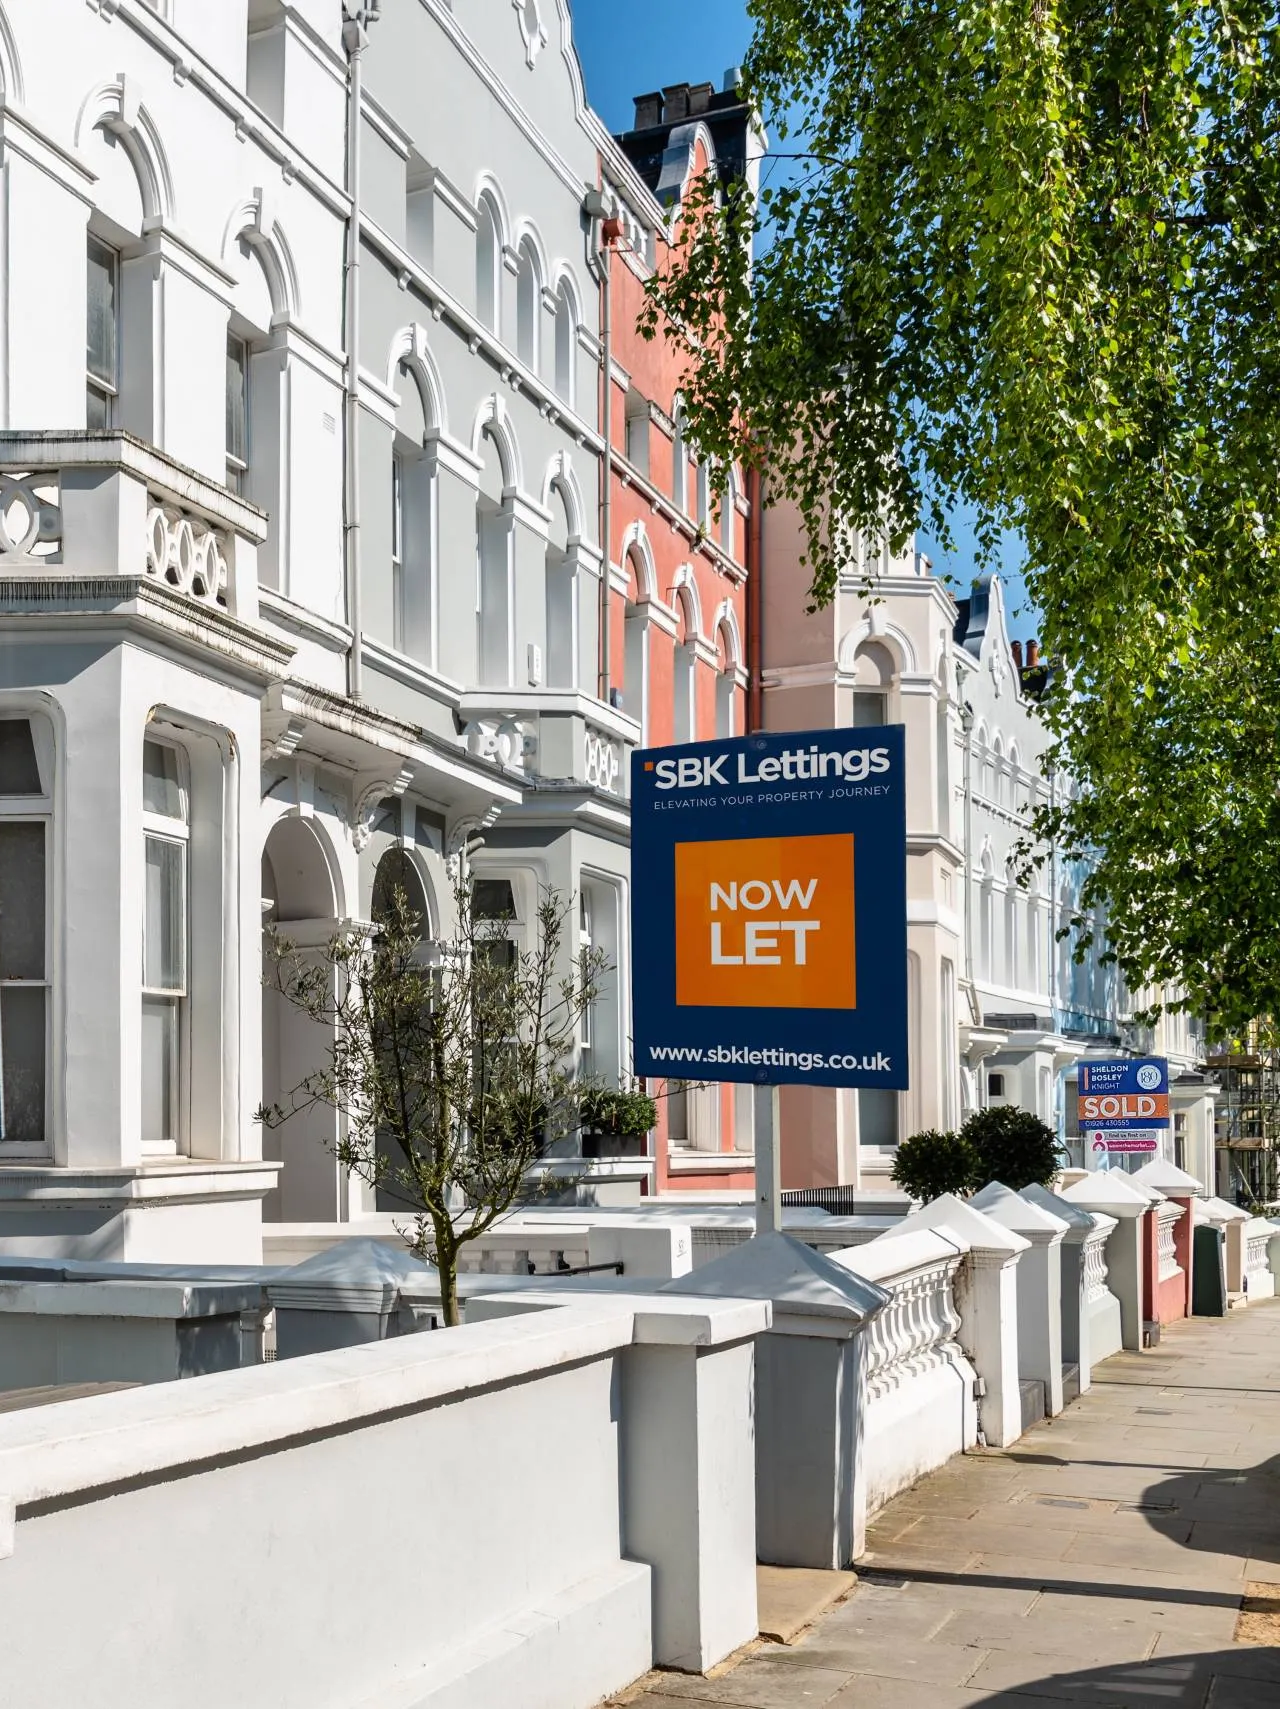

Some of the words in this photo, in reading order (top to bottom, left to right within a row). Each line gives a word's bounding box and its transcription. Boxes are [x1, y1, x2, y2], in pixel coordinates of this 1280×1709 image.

[654, 755, 730, 789] SBK
[737, 745, 891, 783] Lettings
[654, 797, 717, 810] ELEVATING
[721, 795, 753, 805] YOUR
[758, 790, 824, 803] PROPERTY
[828, 785, 890, 799] JOURNEY
[710, 879, 818, 911] NOW
[710, 921, 820, 965] LET
[649, 1046, 891, 1072] www.sbklettings.co.uk
[1091, 1065, 1128, 1073] SHELDON
[1084, 1096, 1156, 1118] SOLD
